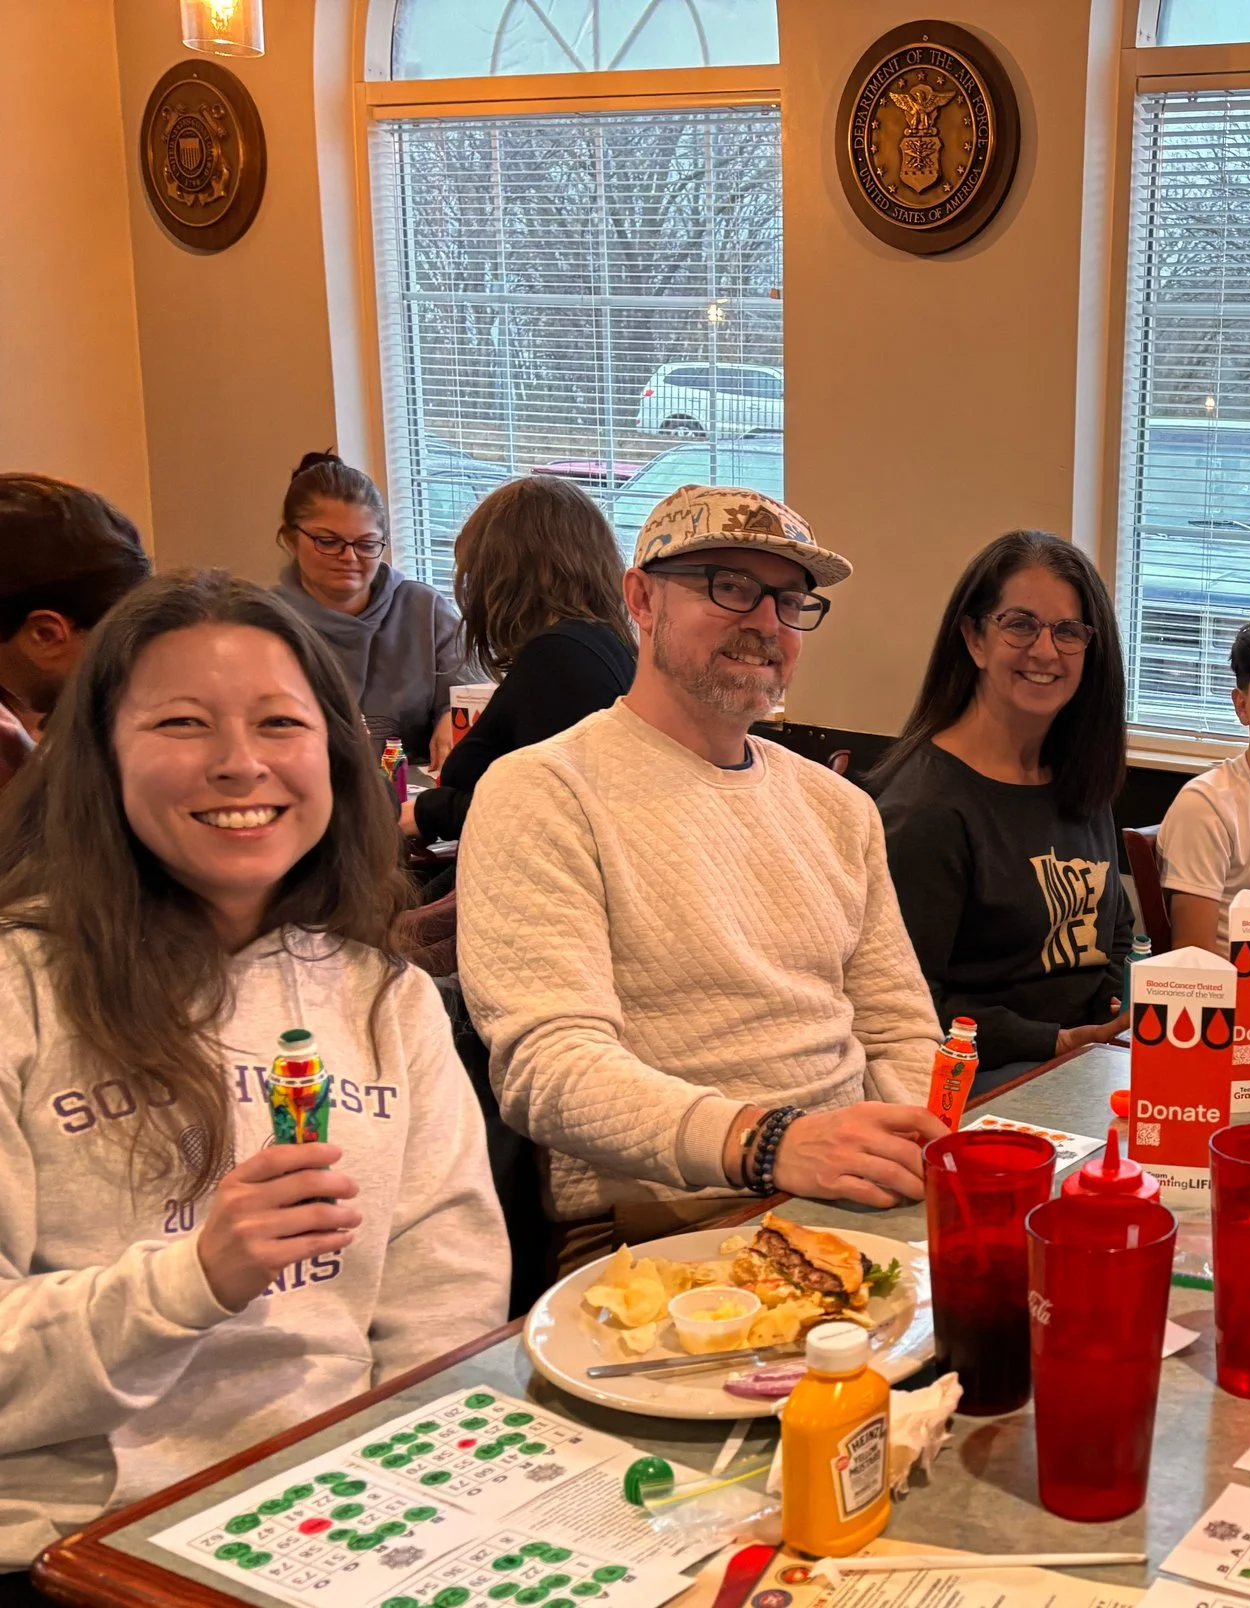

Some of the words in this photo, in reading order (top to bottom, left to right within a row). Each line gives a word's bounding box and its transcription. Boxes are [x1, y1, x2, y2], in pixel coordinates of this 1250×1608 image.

[854, 55, 901, 149] DEPARTMENT
[906, 50, 923, 64] OF
[929, 50, 954, 70] THE
[955, 68, 975, 93] AIR
[972, 97, 989, 148] FORCE
[859, 167, 890, 211] UNITED
[892, 206, 926, 223] STATES
[928, 207, 943, 221] OF
[946, 168, 982, 213] AMERICA
[1146, 980, 1168, 988] Blood
[1169, 981, 1196, 990] Cancer
[1146, 988, 1185, 997] Visionaries
[1208, 991, 1225, 999] Year
[1137, 1100, 1220, 1124] Donate
[484, 1426, 501, 1434] 25
[312, 1496, 333, 1506] 22
[385, 1500, 405, 1510] 13
[356, 1514, 379, 1525] 23
[254, 1528, 276, 1538] 47
[200, 1534, 223, 1545] 62
[276, 1536, 299, 1548] 59
[299, 1546, 321, 1557] 58
[322, 1554, 345, 1565] 51
[268, 1562, 292, 1574] 74
[517, 1566, 545, 1578] 22
[291, 1572, 314, 1584] 73
